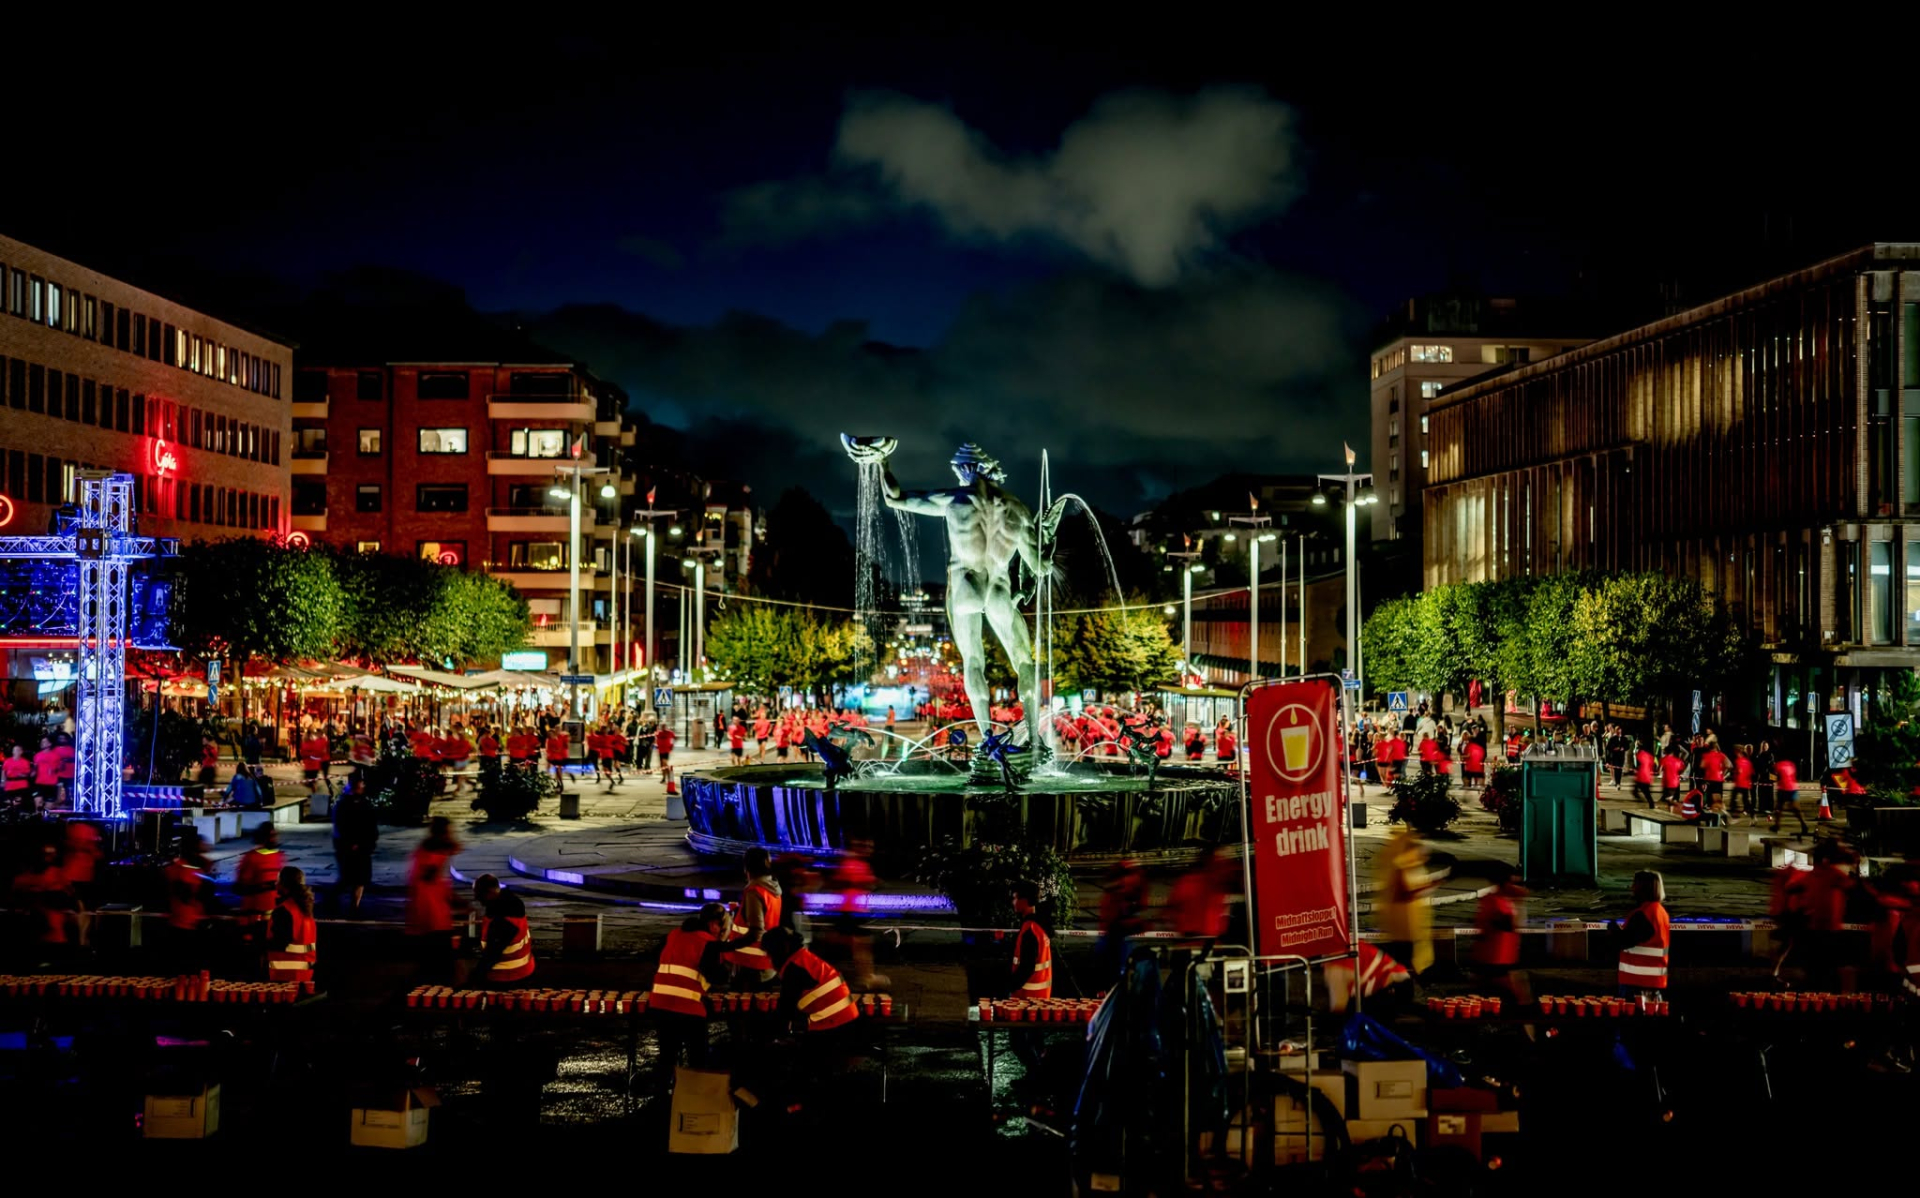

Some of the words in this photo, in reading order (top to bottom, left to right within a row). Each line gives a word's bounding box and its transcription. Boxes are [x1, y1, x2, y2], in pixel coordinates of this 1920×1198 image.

[1266, 792, 1332, 823] Energy
[1276, 823, 1329, 856] drink
[1281, 929, 1317, 947] Midnight
[1318, 926, 1334, 940] Run
